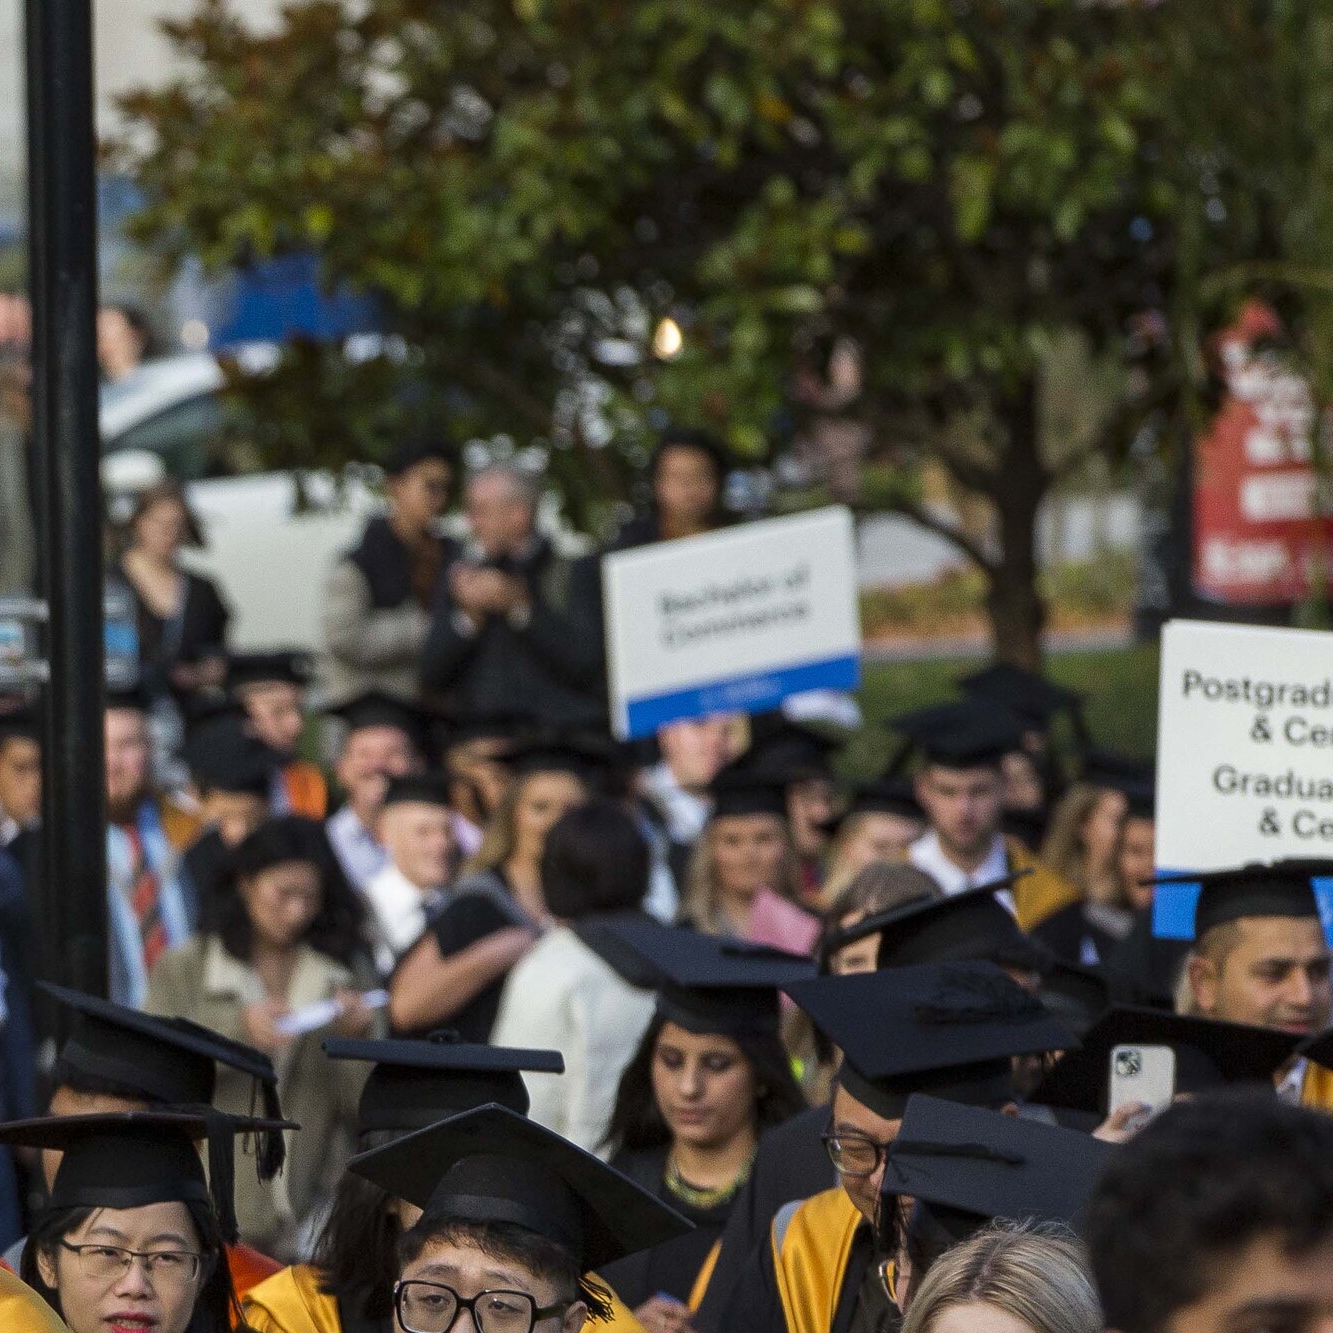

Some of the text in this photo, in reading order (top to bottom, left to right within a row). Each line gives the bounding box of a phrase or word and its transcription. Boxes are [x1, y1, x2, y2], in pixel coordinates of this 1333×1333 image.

[660, 563, 811, 614] Bachelor of
[660, 601, 809, 648] Commerce
[1250, 715, 1271, 742] &
[1213, 763, 1333, 800] Gradua
[1258, 806, 1280, 836] &
